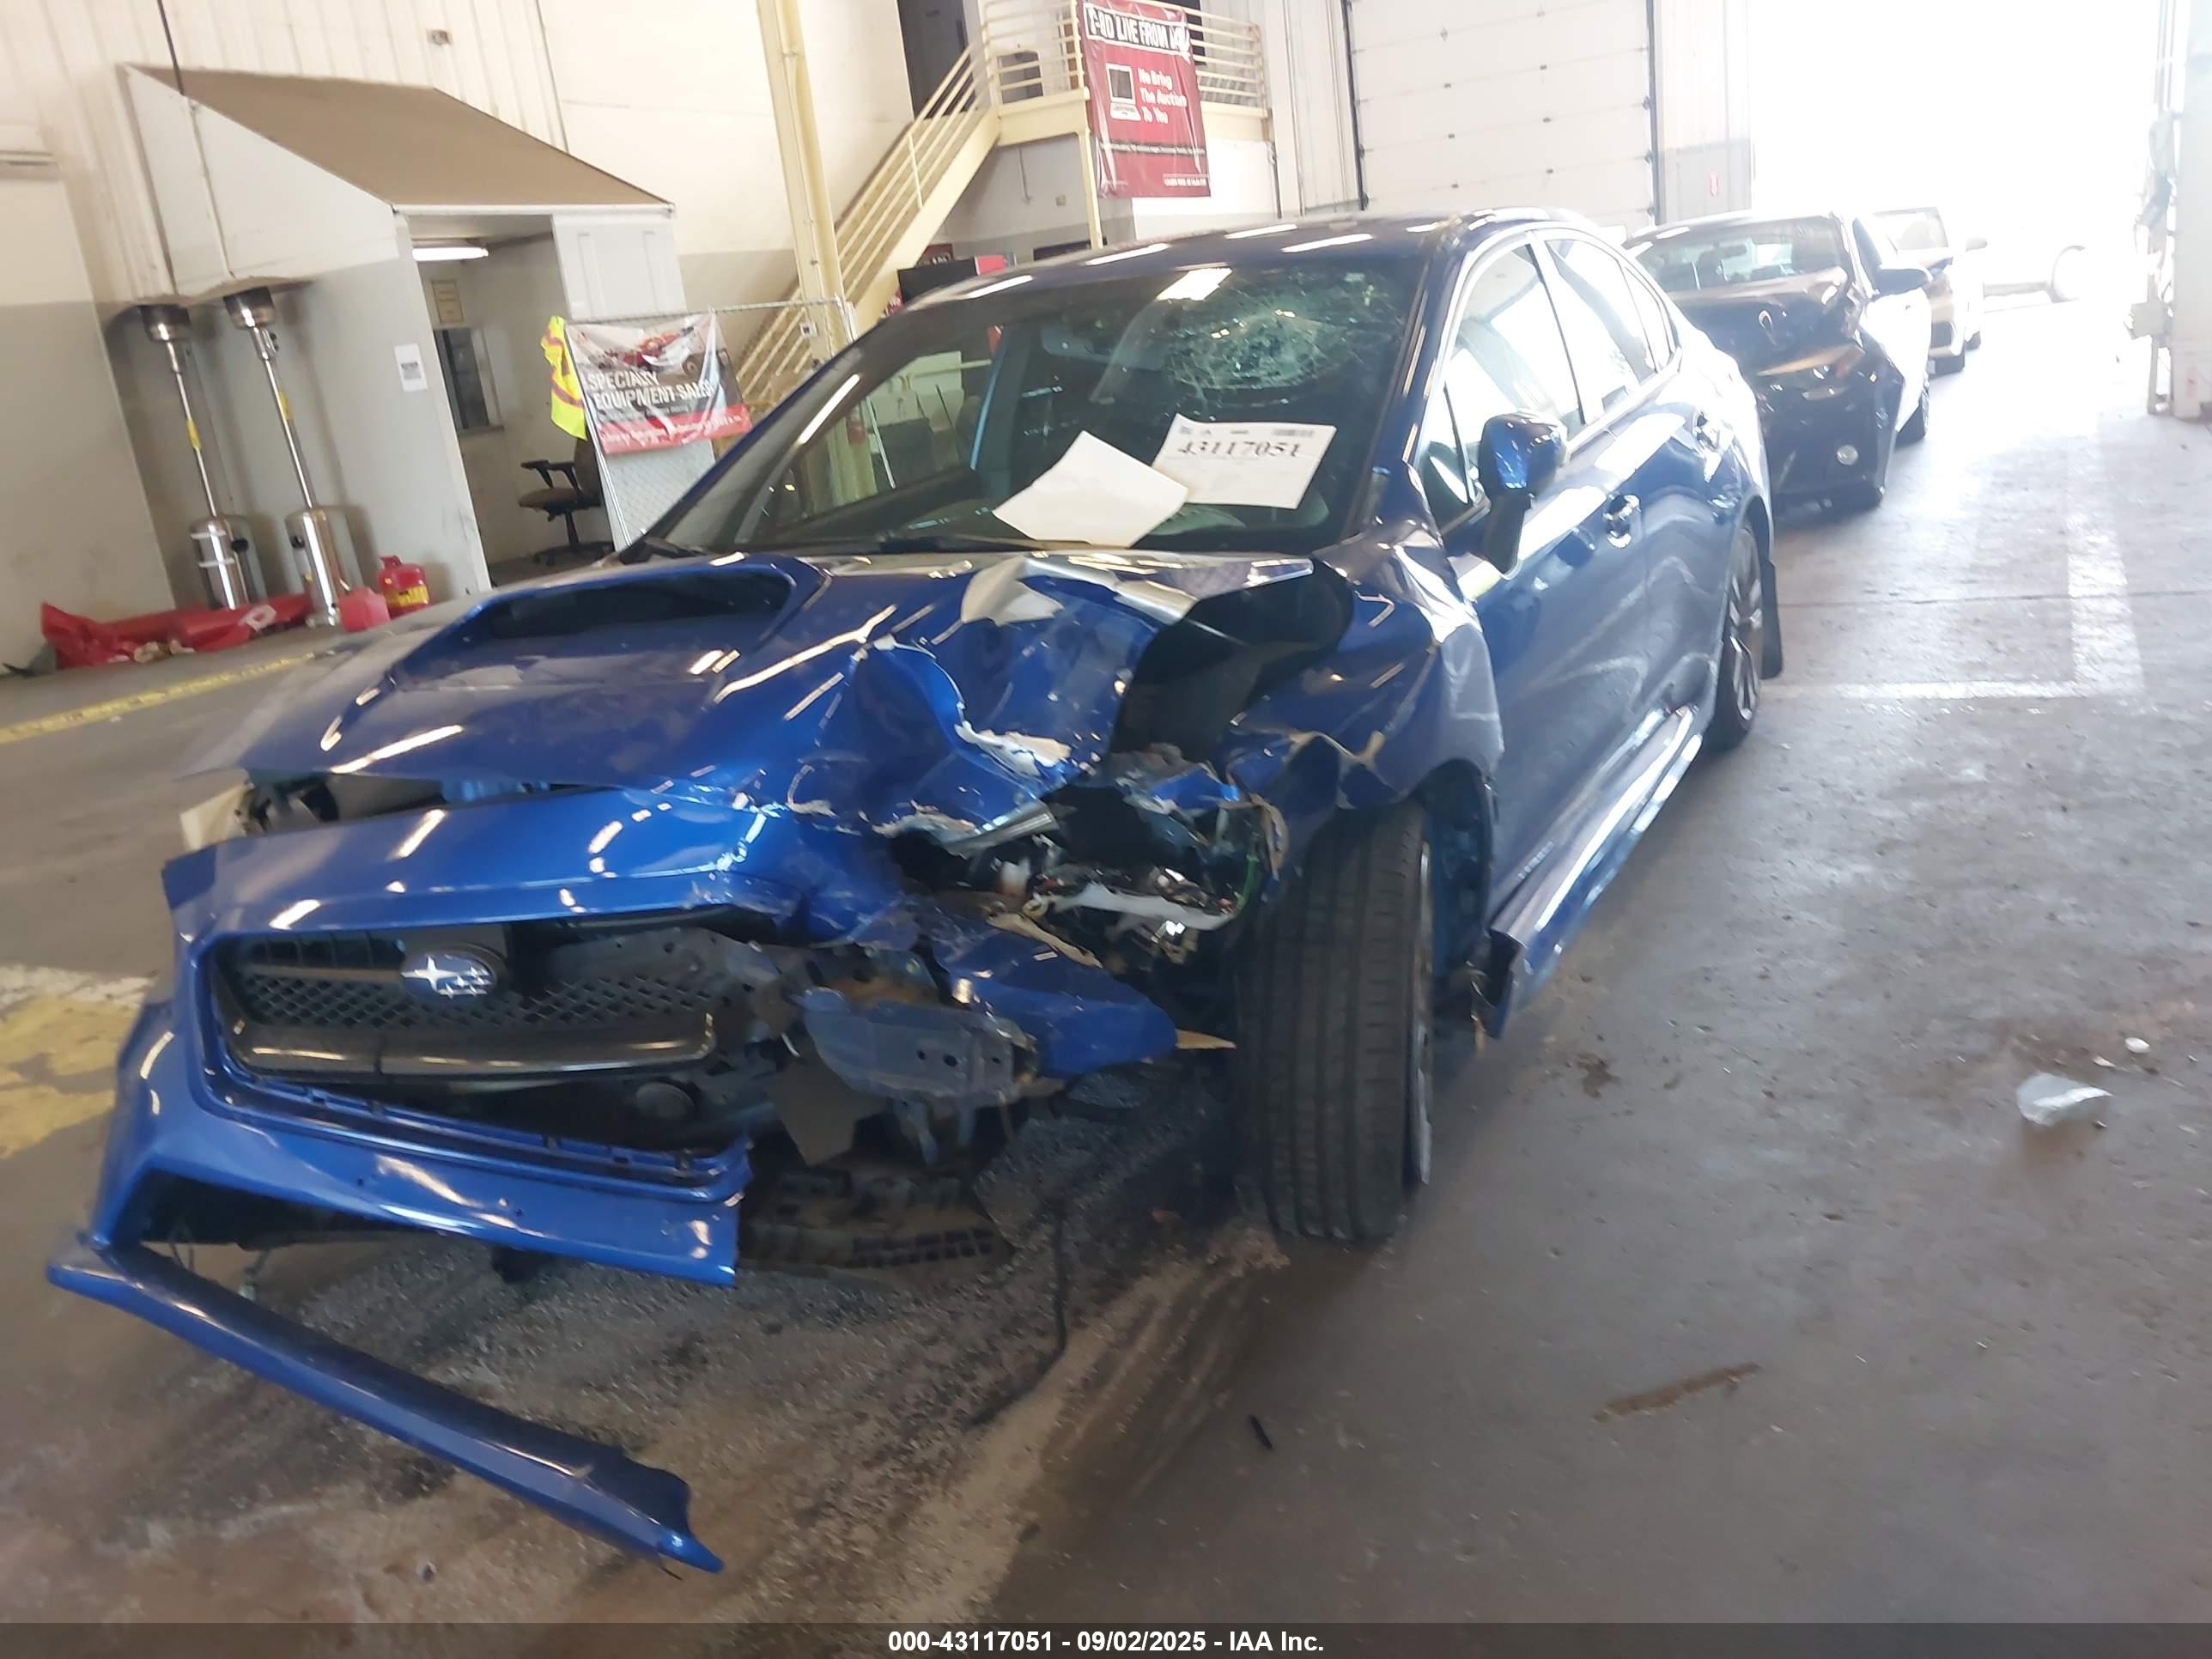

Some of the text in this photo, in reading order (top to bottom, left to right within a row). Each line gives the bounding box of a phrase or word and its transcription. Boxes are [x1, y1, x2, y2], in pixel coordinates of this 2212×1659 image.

[1115, 15, 1139, 43] LIVE
[1139, 21, 1170, 49] FROM
[1151, 70, 1173, 90] Bring
[1139, 87, 1188, 107] The Auction
[1141, 106, 1169, 124] To You
[587, 370, 659, 390] SPECIALTY
[592, 384, 677, 410] EQUIPMENT
